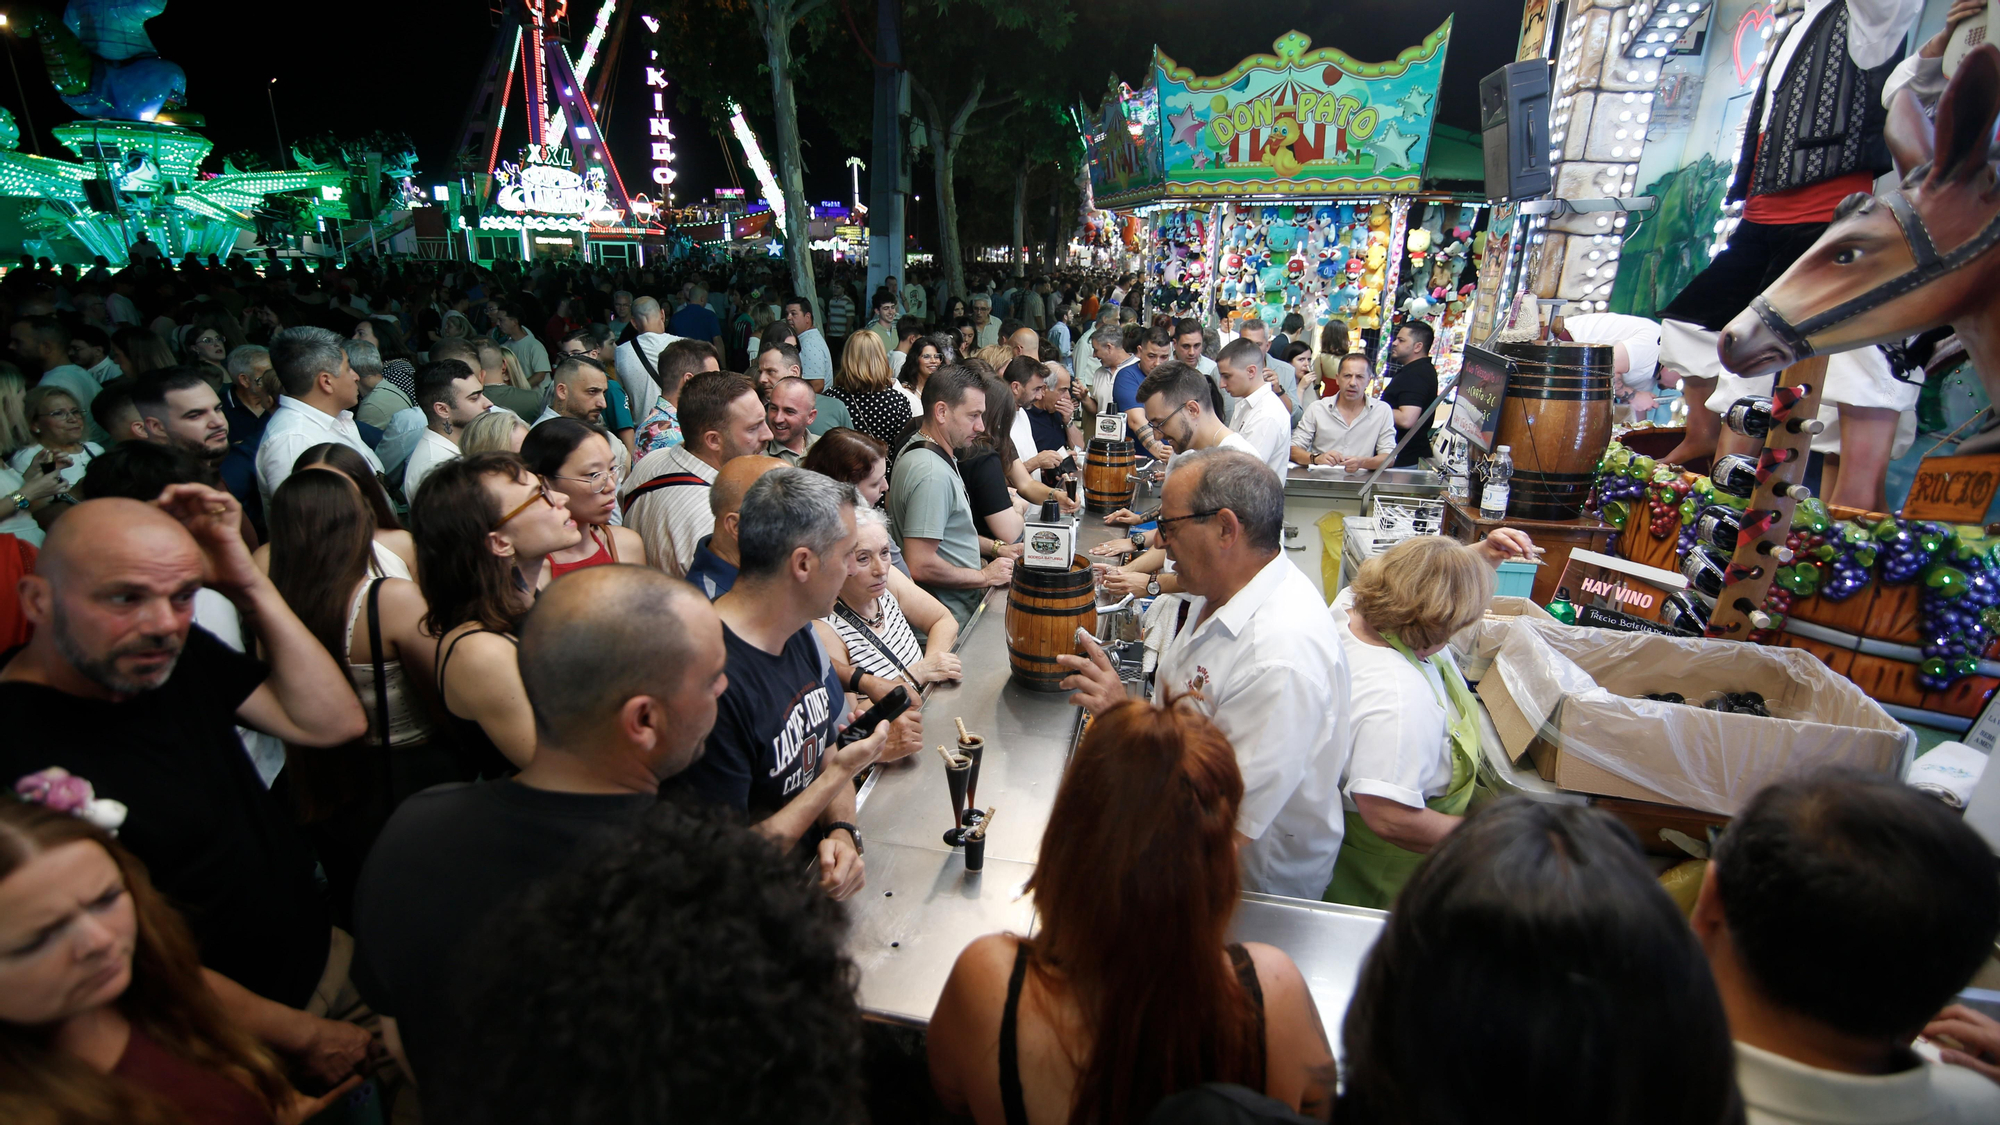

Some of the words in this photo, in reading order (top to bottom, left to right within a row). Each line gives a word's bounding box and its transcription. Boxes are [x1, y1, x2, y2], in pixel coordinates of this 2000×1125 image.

[1210, 95, 1275, 146] DON
[1296, 90, 1380, 141] PATO
[527, 144, 572, 166] XXL
[1580, 577, 1613, 597] HAY
[1614, 586, 1654, 609] VINO
